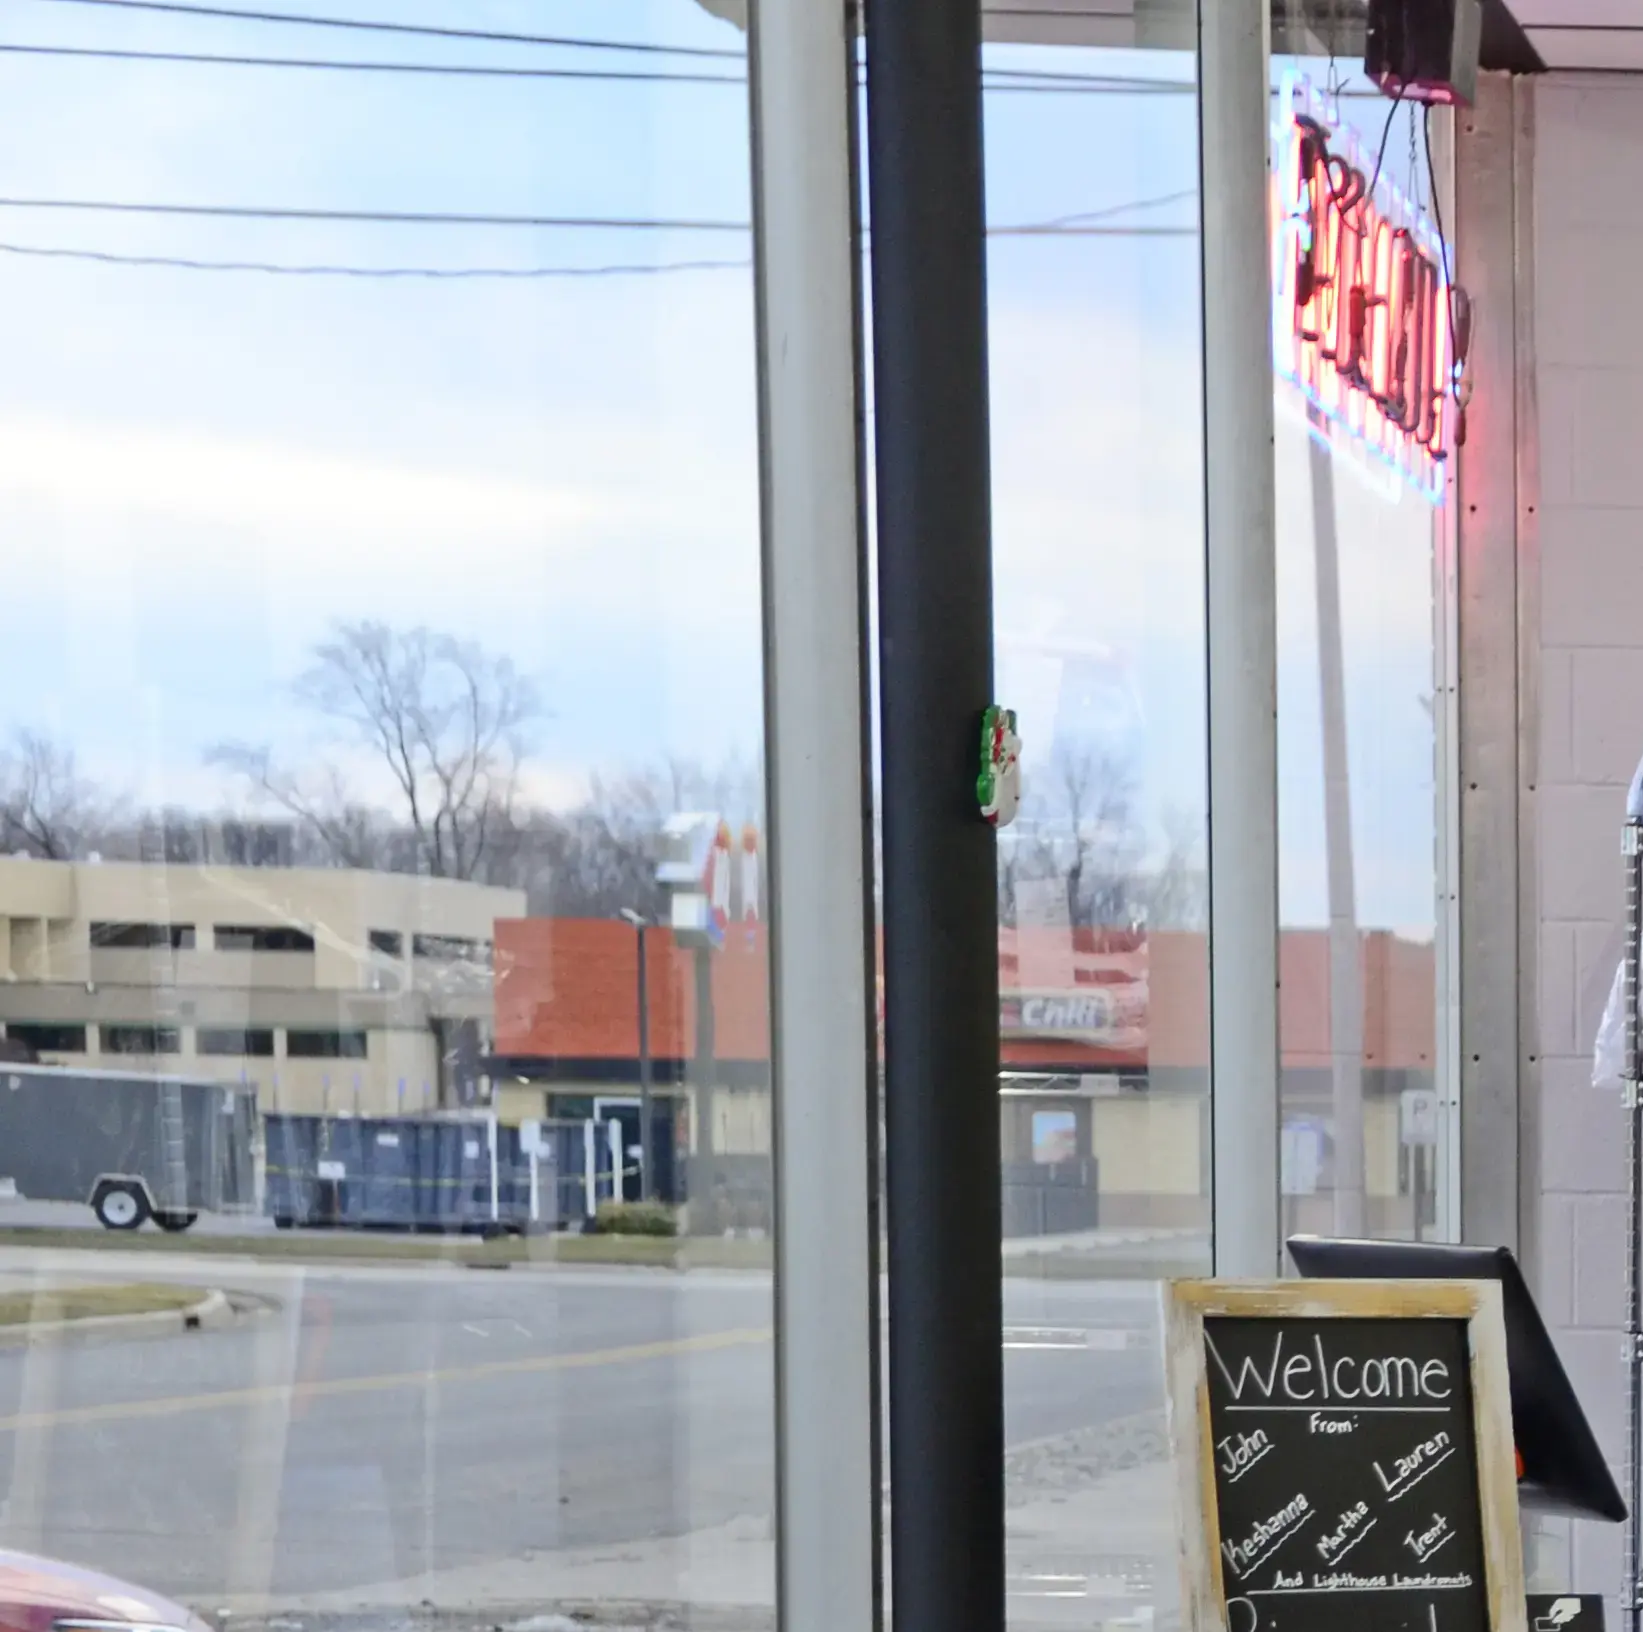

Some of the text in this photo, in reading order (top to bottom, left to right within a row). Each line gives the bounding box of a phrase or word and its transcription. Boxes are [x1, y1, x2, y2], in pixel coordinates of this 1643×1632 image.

[1201, 1328, 1452, 1400] Welcome
[1309, 1411, 1360, 1435] From:
[1217, 1428, 1269, 1475] John
[1372, 1430, 1450, 1493] Lauren
[1315, 1500, 1370, 1559] Martha
[1403, 1512, 1448, 1557] Trent
[1272, 1569, 1304, 1590] And
[1312, 1571, 1388, 1589] Lighthouse
